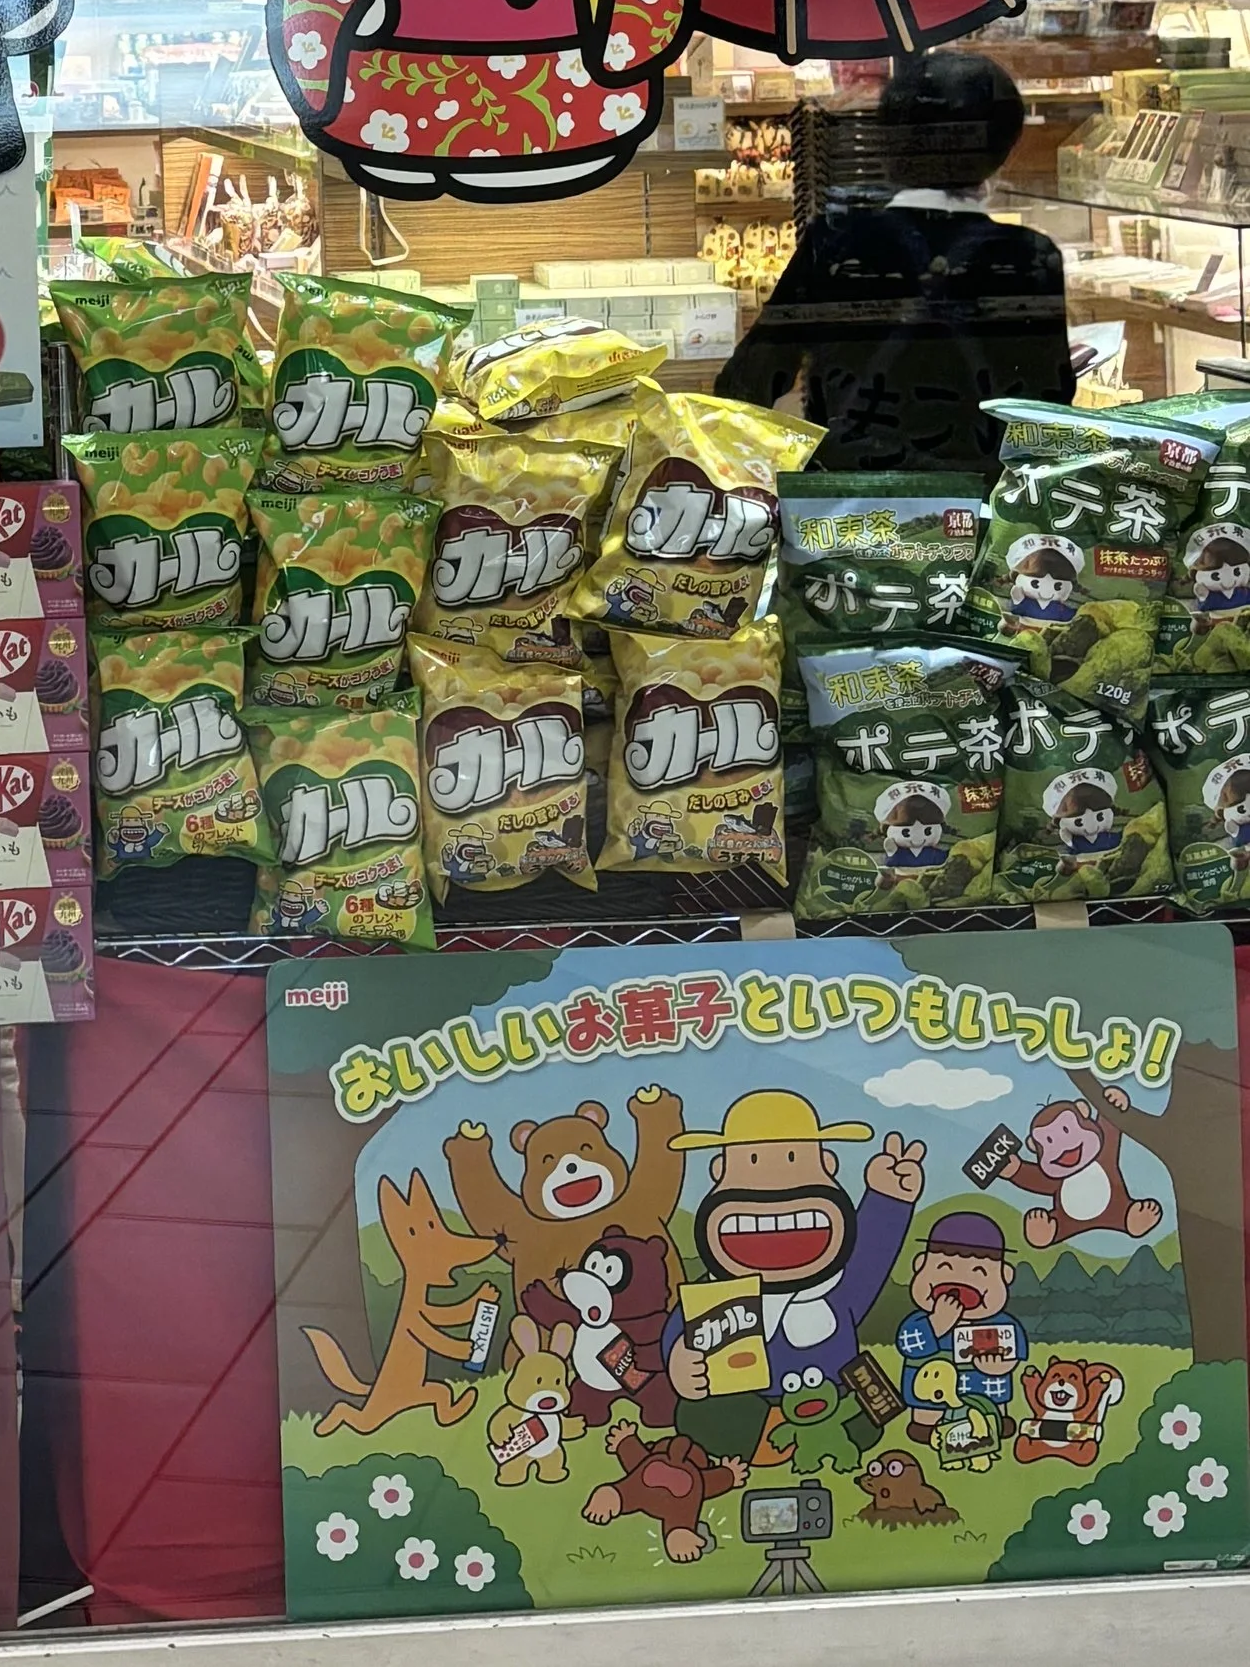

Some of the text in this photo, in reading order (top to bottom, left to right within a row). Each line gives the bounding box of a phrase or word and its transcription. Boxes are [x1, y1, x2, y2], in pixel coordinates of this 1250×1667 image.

[75, 294, 110, 308] meiji
[83, 366, 236, 431] カール
[272, 373, 432, 451] カール
[84, 445, 120, 462] meiji
[261, 497, 297, 513] meiji
[625, 481, 777, 563] カール
[87, 525, 242, 609] カール
[432, 525, 585, 607] カール
[260, 585, 412, 663] カール
[804, 568, 970, 633] ポテ茶
[1096, 682, 1132, 706] 120g
[97, 694, 246, 797] カール
[427, 714, 586, 815] カール
[624, 698, 780, 790] カール
[835, 713, 1005, 776] ポテ茶
[152, 766, 239, 812] チーズがコクうま!
[185, 814, 215, 835] 6種
[278, 774, 419, 867] カール
[314, 854, 406, 891] チーズがコクうま!
[345, 895, 376, 915] 6種
[352, 912, 404, 925] のブレンド
[285, 982, 349, 1011] meiji
[336, 972, 1184, 1123] おいしいお菓子といつもいっしょ!
[970, 1133, 1015, 1181] BLACK
[473, 1305, 495, 1352] XYLISH
[693, 1305, 757, 1352] カール
[956, 1328, 1013, 1343] ALND
[853, 1365, 897, 1417] meiji
